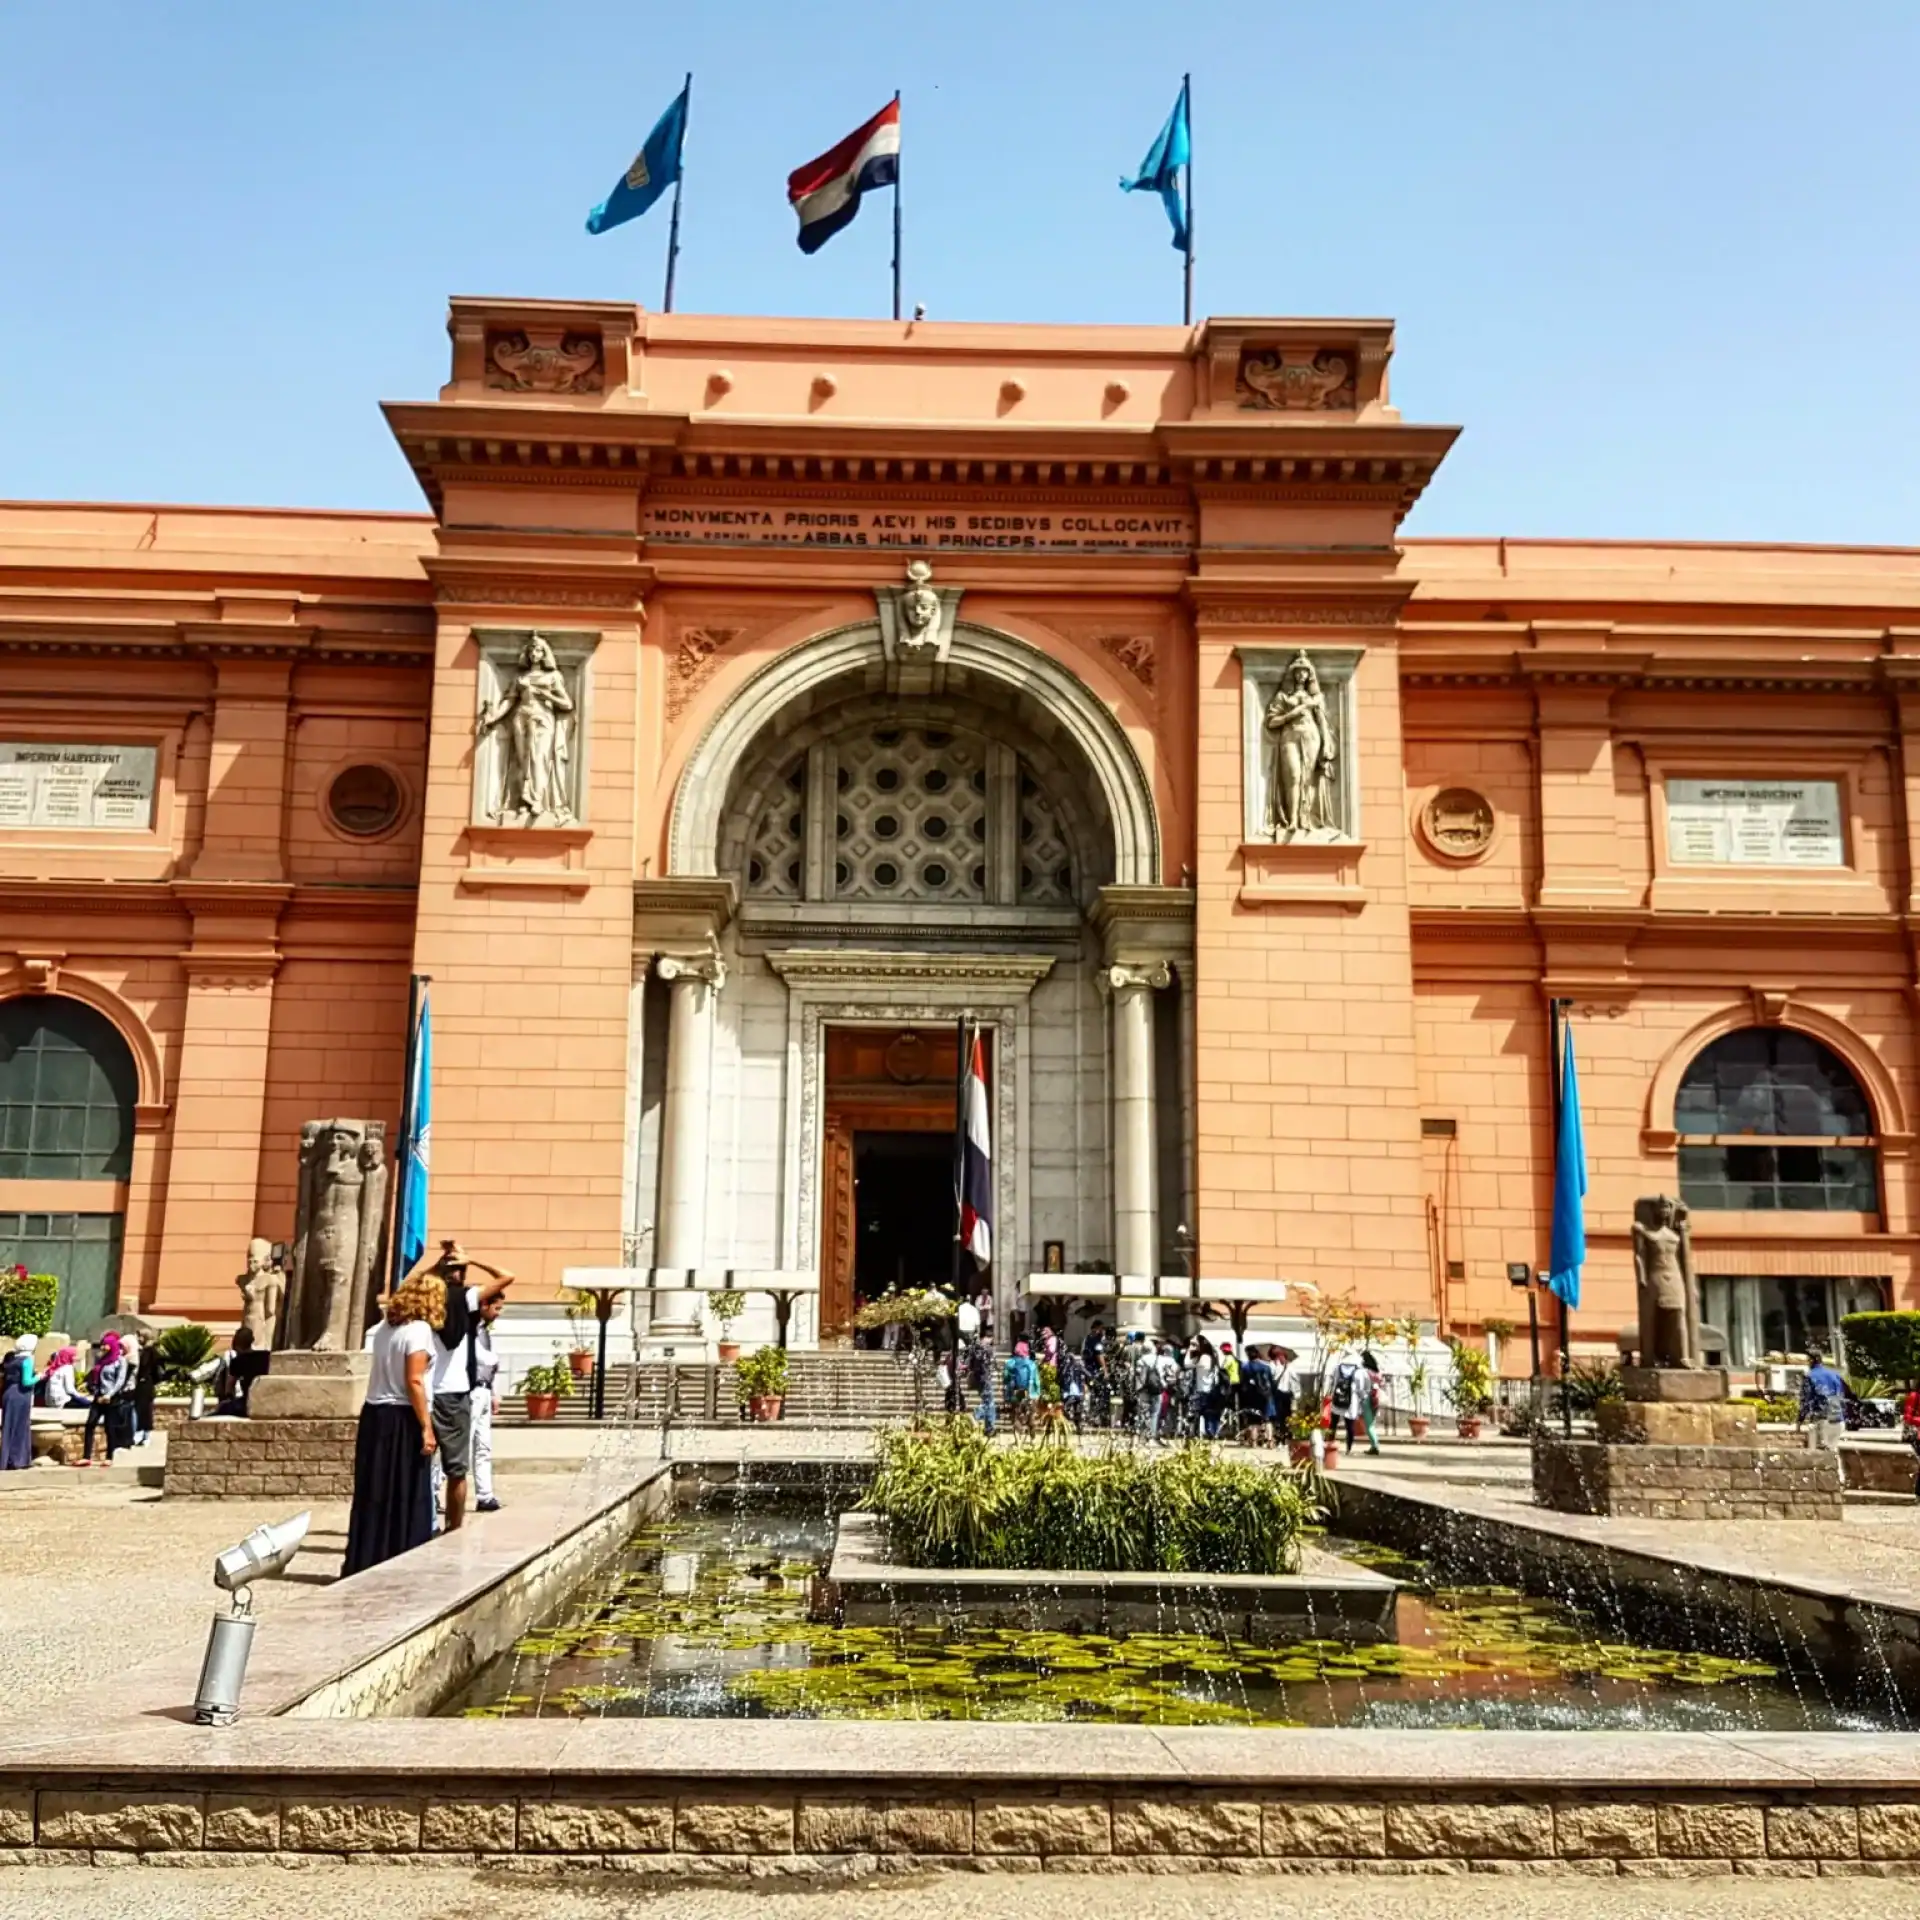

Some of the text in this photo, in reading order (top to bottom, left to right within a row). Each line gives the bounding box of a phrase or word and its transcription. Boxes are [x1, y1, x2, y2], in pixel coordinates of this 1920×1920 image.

[654, 509, 1182, 534] MONVMENTA PRIORIS AEVI HIS SEDIBVS COLLOCAVIT
[804, 531, 867, 545] ABBAS
[879, 532, 928, 546] HILMI
[938, 533, 1035, 548] PRINCEPS
